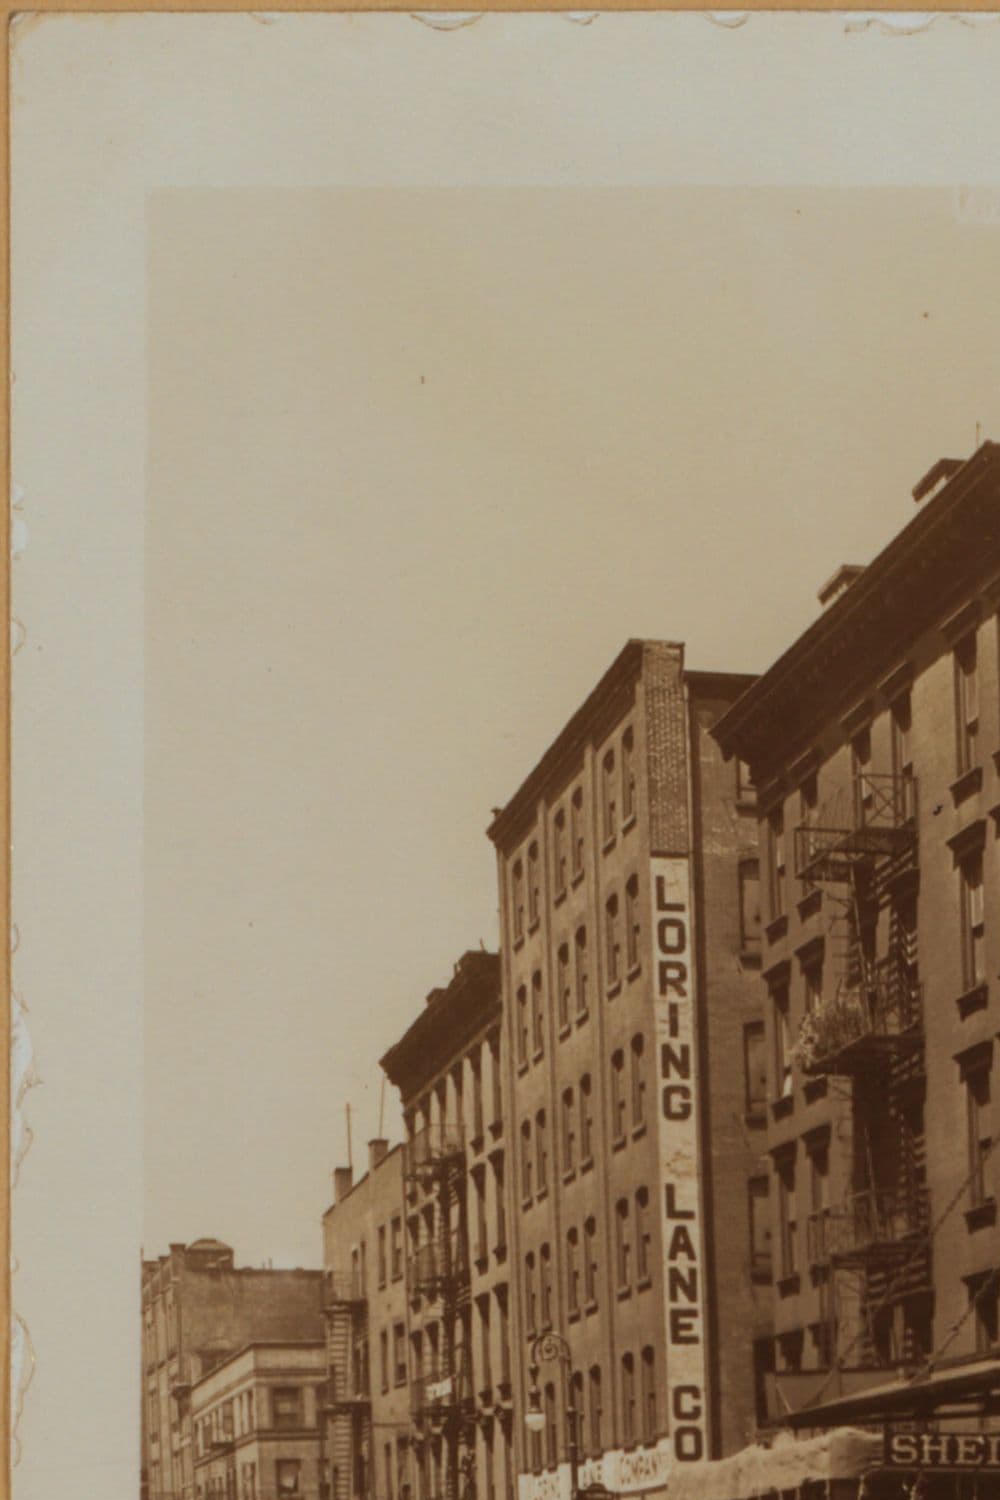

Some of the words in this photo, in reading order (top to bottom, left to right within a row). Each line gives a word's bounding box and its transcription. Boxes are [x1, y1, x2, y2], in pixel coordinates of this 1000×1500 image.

[655, 875, 693, 1121] LORING
[665, 1183, 700, 1345] LANE
[673, 1385, 702, 1461] CO
